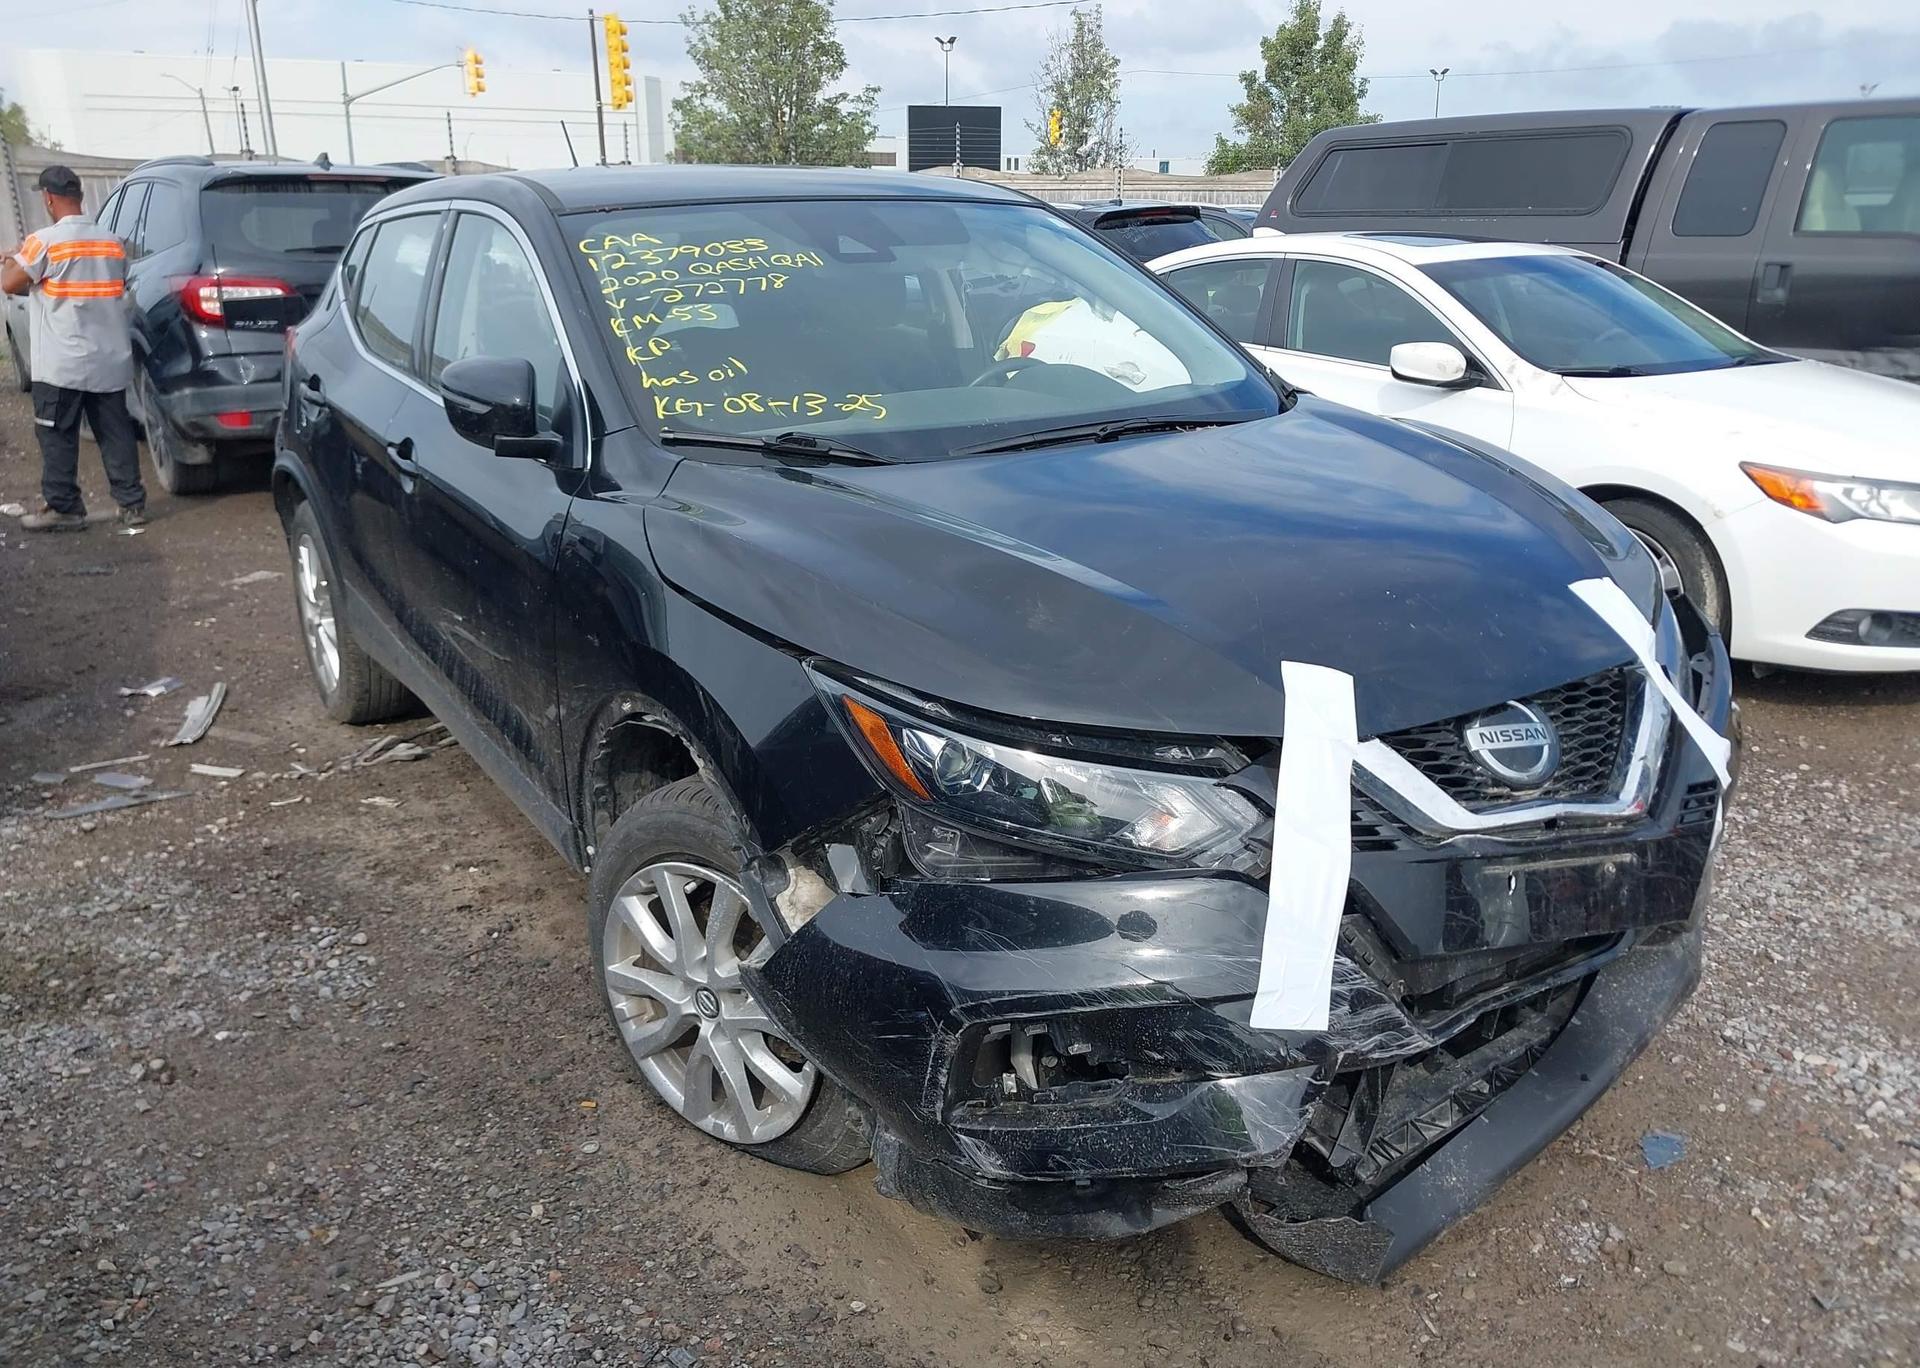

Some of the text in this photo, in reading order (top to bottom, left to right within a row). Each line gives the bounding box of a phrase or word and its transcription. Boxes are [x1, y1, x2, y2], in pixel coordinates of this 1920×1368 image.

[579, 232, 664, 254] CAA
[587, 238, 769, 272] 12379033
[600, 270, 681, 295] 2020
[641, 356, 749, 389] has oil
[1478, 727, 1548, 745] NISSAN
